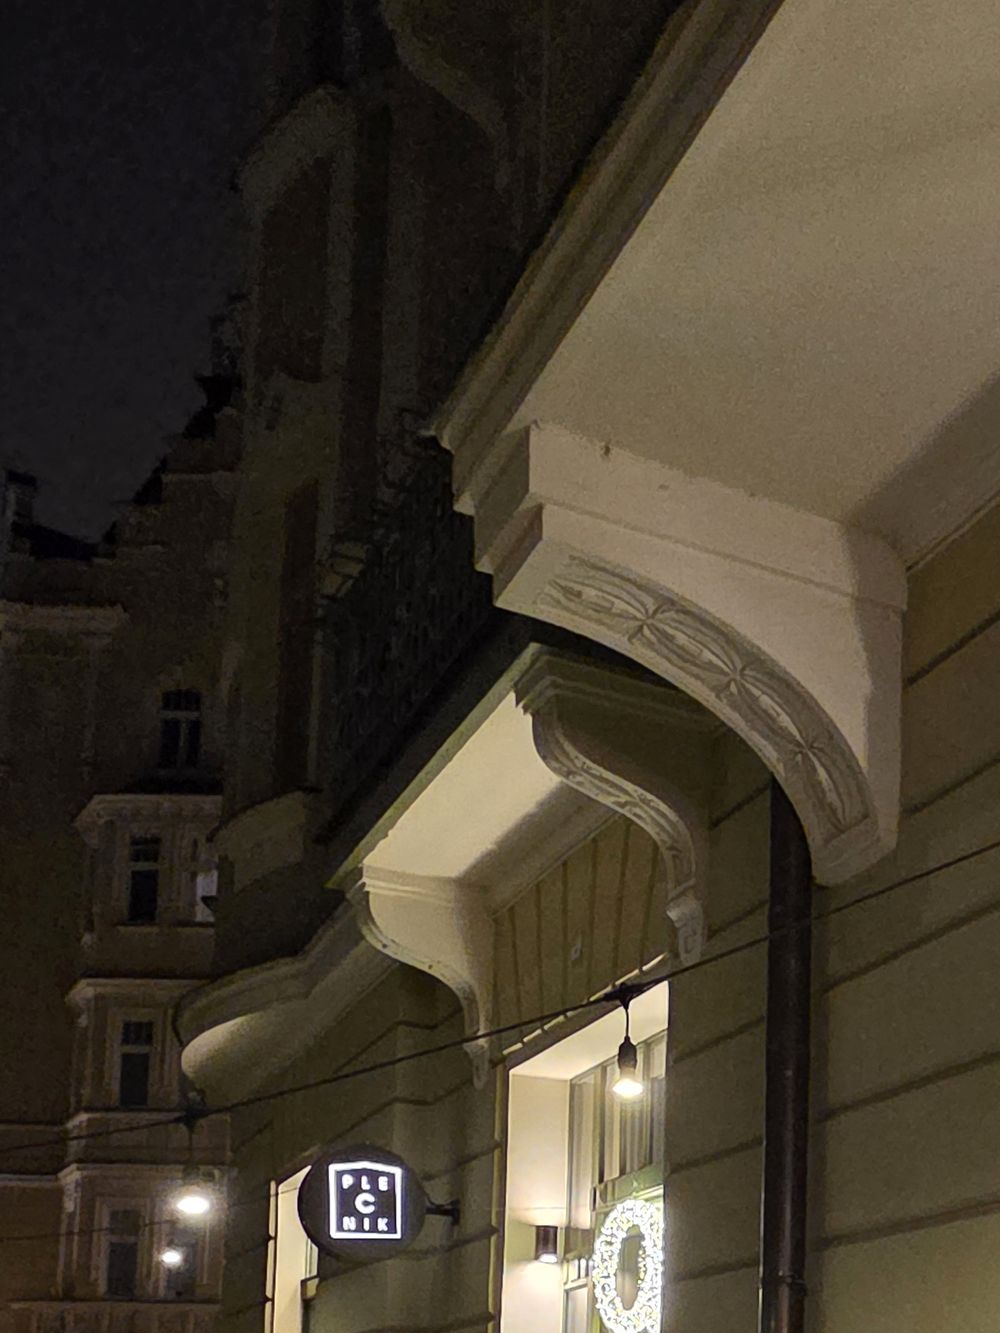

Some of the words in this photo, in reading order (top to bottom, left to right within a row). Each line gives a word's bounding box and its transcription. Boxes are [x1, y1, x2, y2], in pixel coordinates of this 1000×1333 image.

[341, 1174, 389, 1192] PLE
[354, 1193, 376, 1214] C
[342, 1217, 389, 1231] NIK
